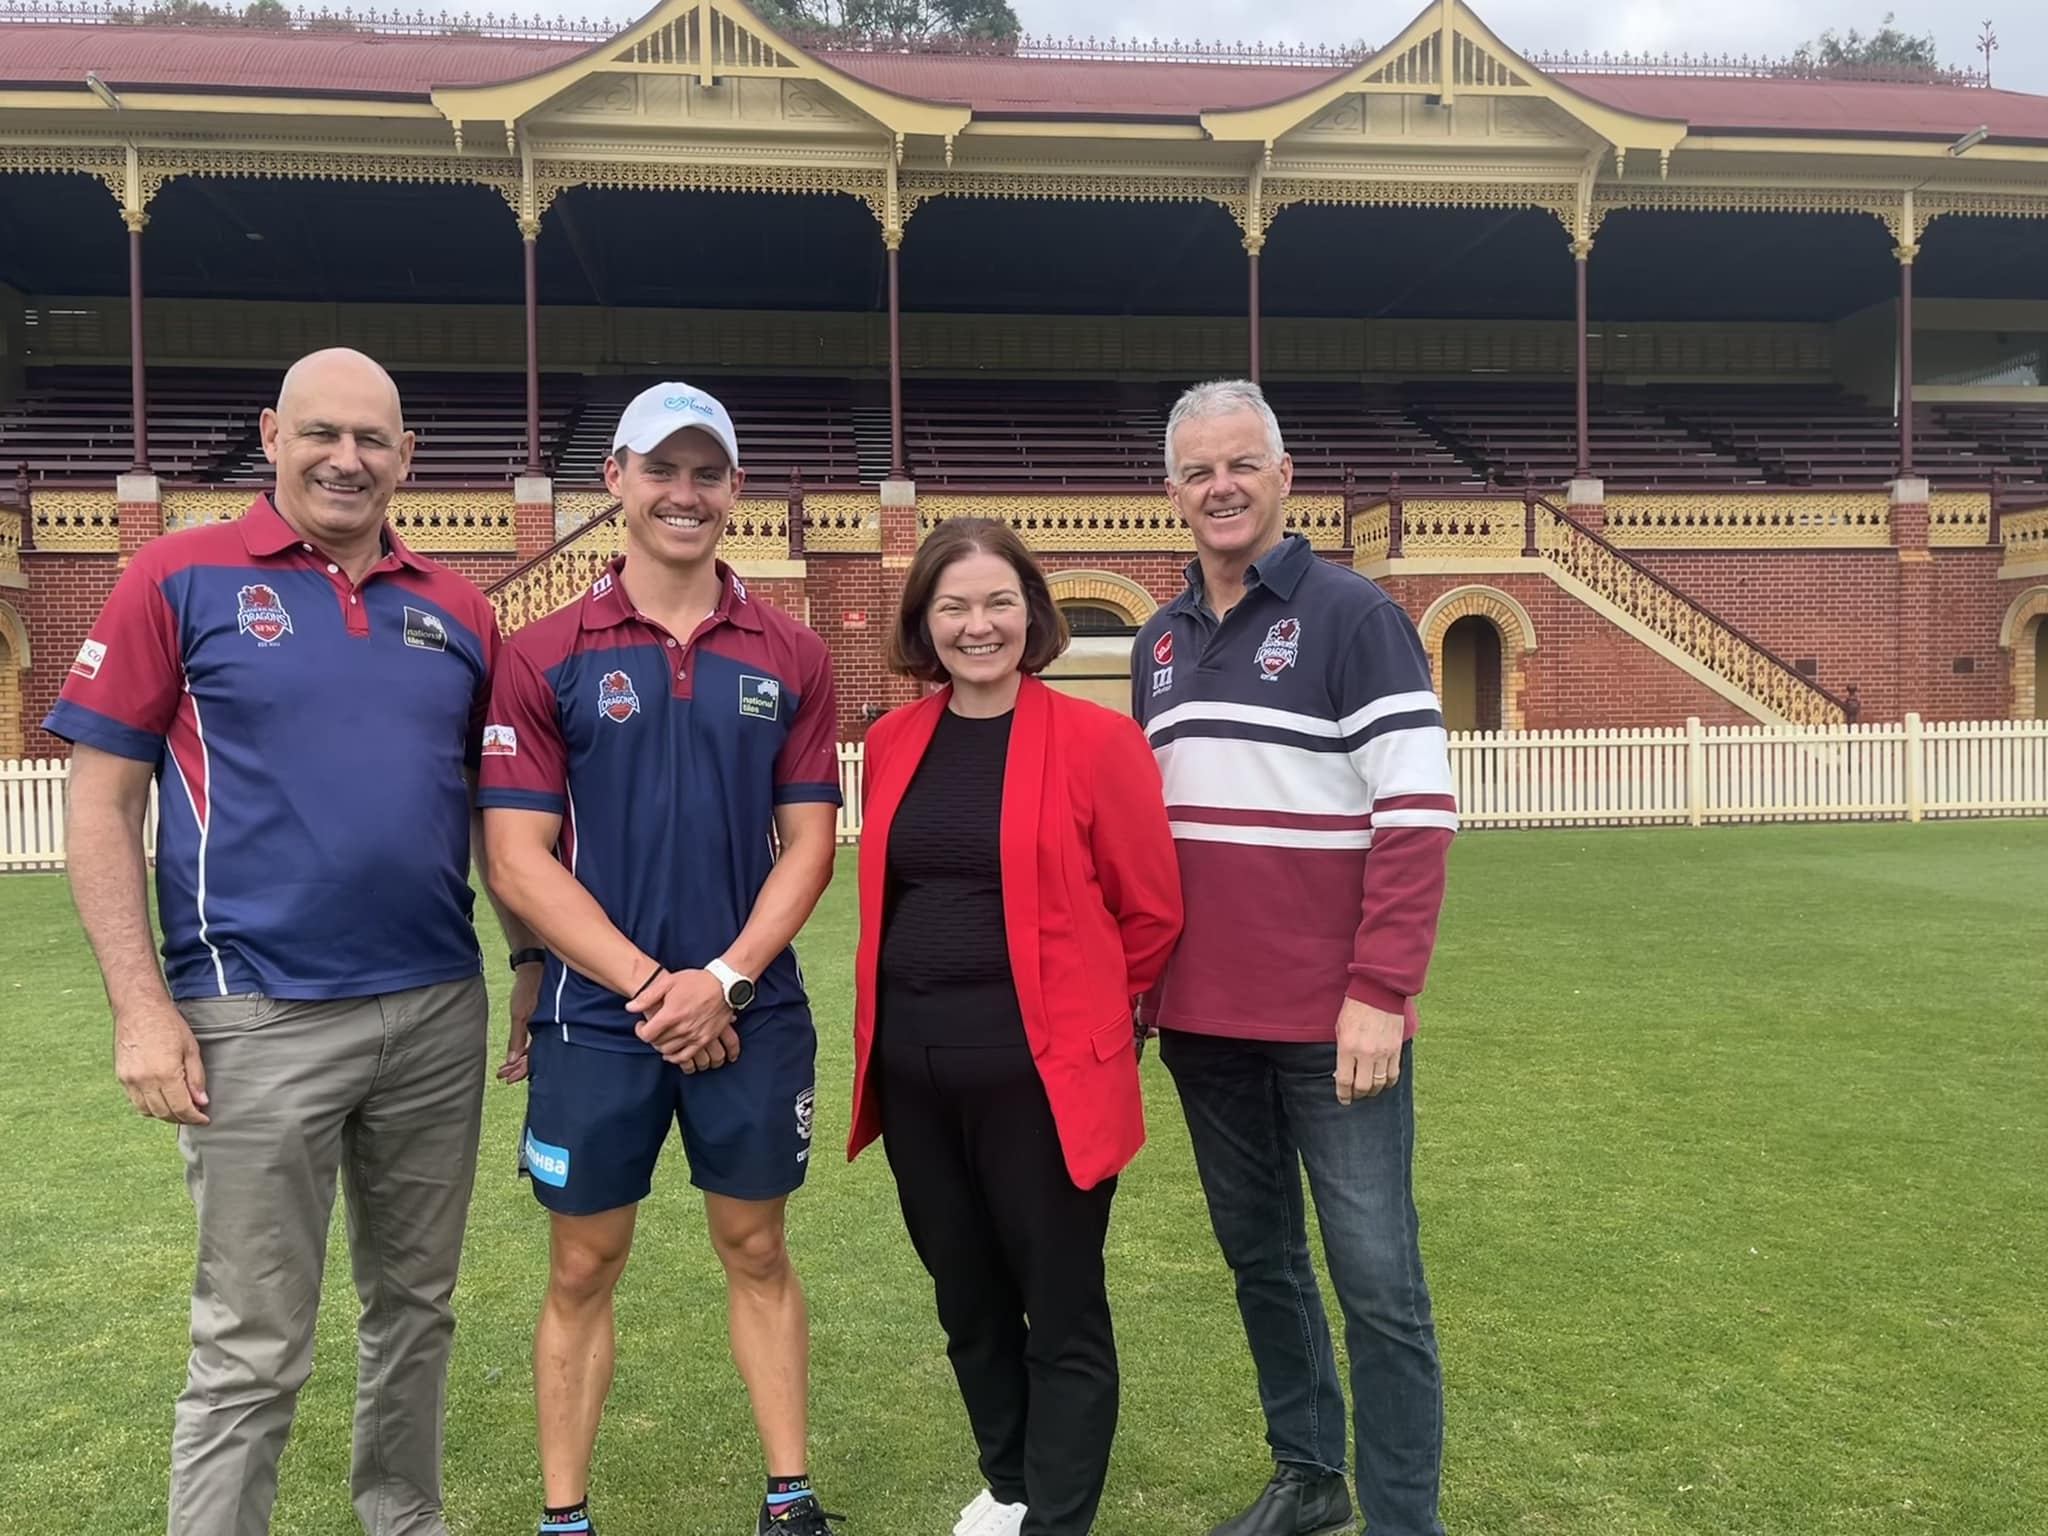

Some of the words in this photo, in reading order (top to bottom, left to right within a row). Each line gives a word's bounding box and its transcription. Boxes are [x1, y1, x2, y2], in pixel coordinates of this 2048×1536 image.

[242, 612, 287, 626] DRAGONS
[407, 629, 442, 641] national
[407, 636, 425, 645] tiles
[602, 696, 636, 711] DRAGONS
[743, 697, 774, 708] national
[743, 704, 759, 713] tiles
